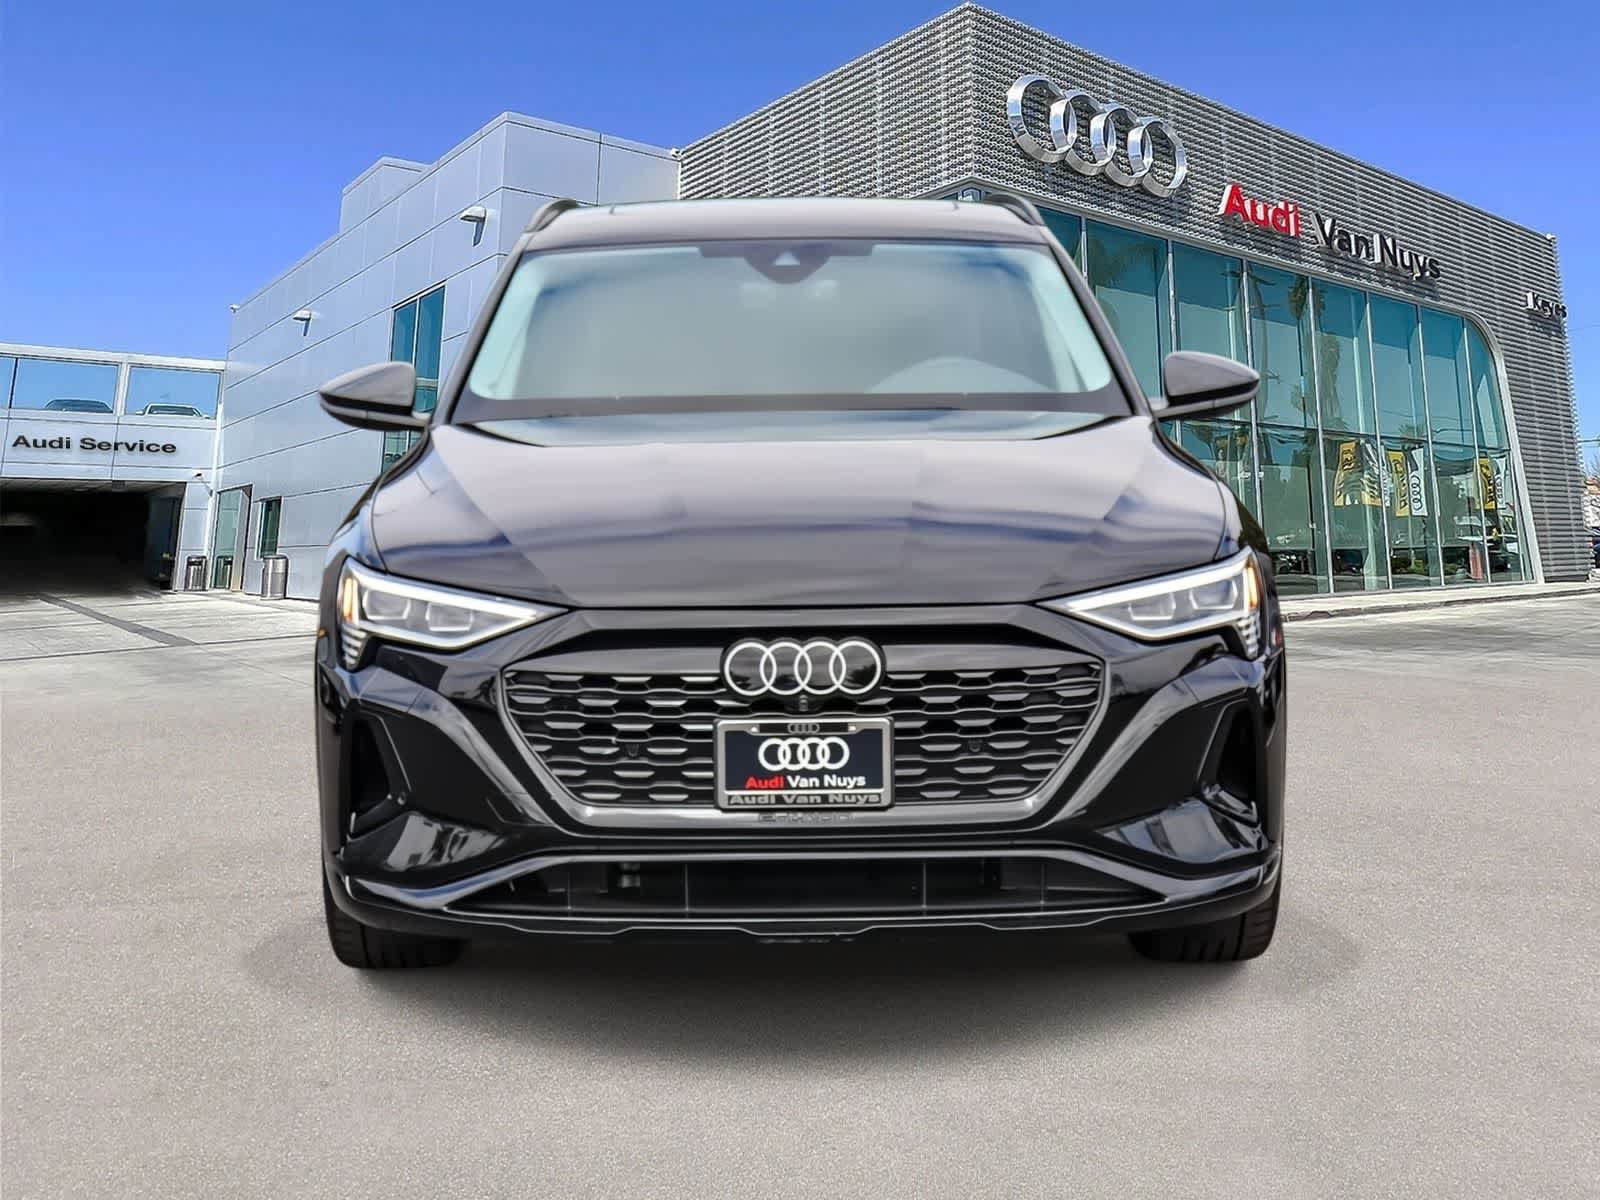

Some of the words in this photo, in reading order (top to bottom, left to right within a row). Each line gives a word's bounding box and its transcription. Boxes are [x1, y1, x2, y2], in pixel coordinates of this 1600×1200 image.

[1221, 183, 1302, 238] Audi
[1311, 212, 1370, 260] Van
[1374, 232, 1441, 281] Nuys
[12, 435, 71, 449] Audi
[79, 437, 177, 454] Service
[745, 774, 785, 790] Audi
[786, 775, 820, 789] Van
[823, 774, 866, 790] Nuys
[729, 794, 776, 806] Audi
[781, 794, 822, 805] Van
[828, 793, 880, 806] Nuys
